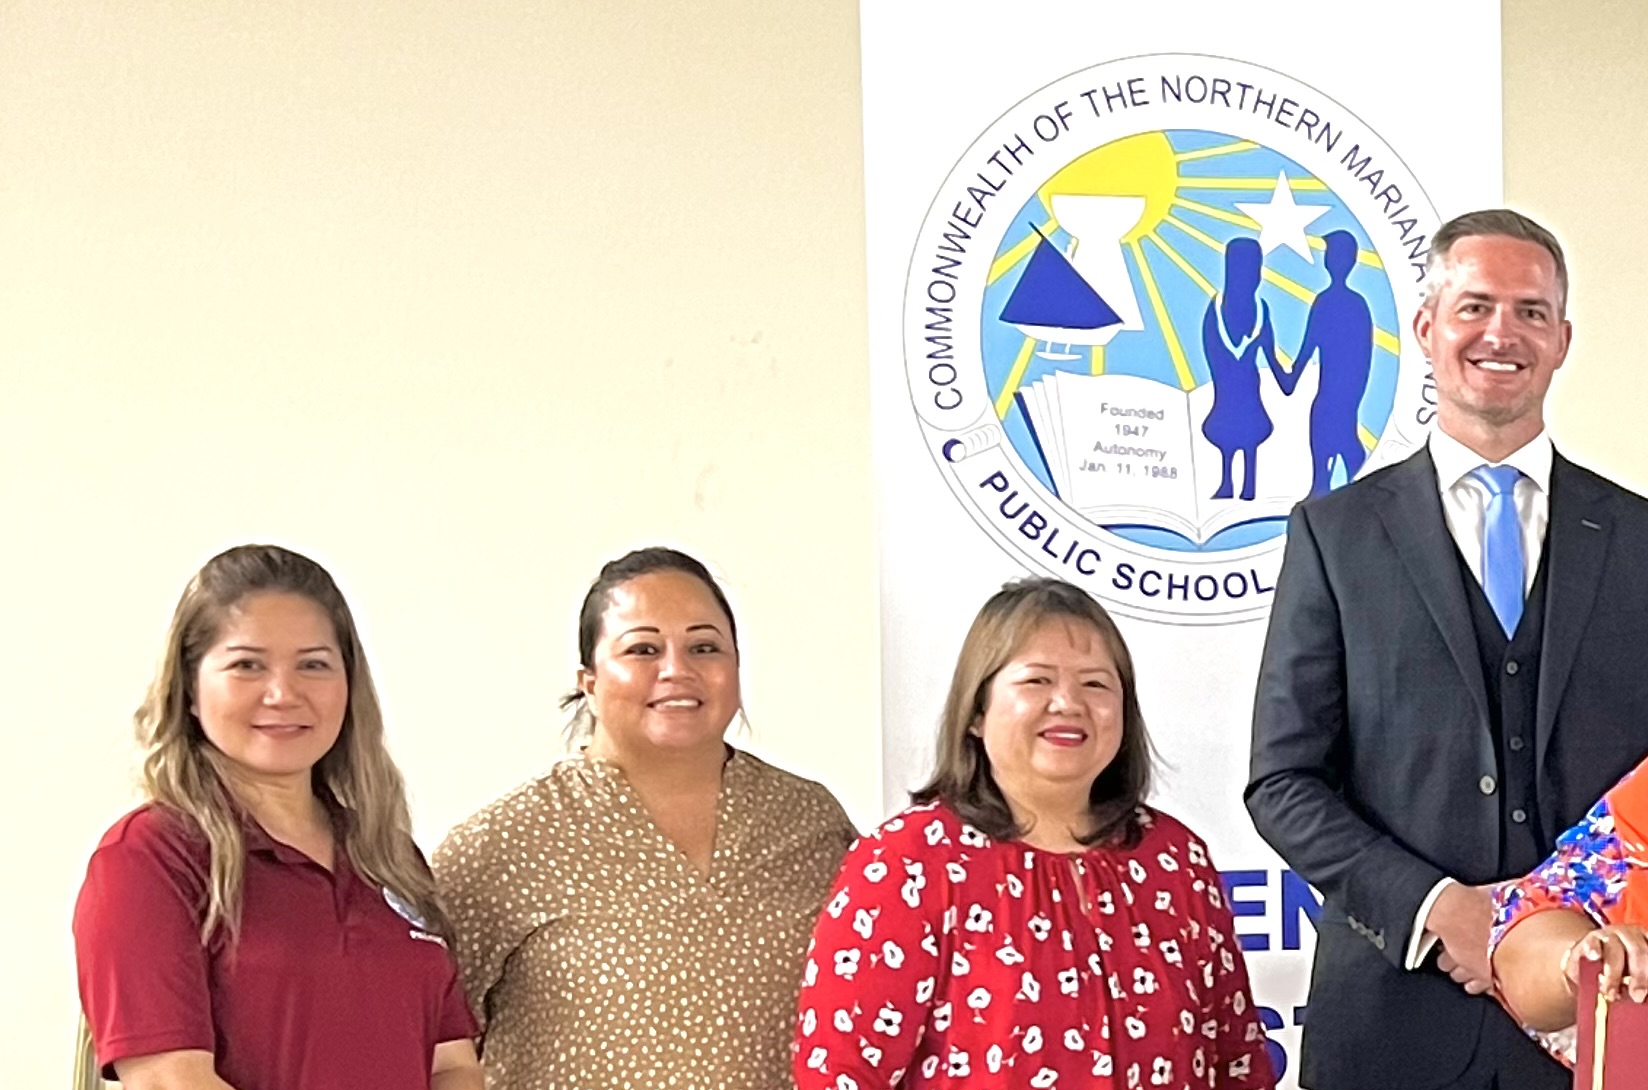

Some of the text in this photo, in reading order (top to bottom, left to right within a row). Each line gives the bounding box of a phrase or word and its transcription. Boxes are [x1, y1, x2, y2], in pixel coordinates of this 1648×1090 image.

[925, 133, 1036, 411] COMMONWEALTH
[1032, 101, 1074, 143] OF
[1080, 76, 1150, 118] THE
[1160, 74, 1343, 154] NORTHERN
[1100, 402, 1165, 421] Founded
[1114, 423, 1150, 438] 1947
[1093, 440, 1168, 463] Autonomy
[978, 470, 1276, 602] PUBLIC SCHOOL
